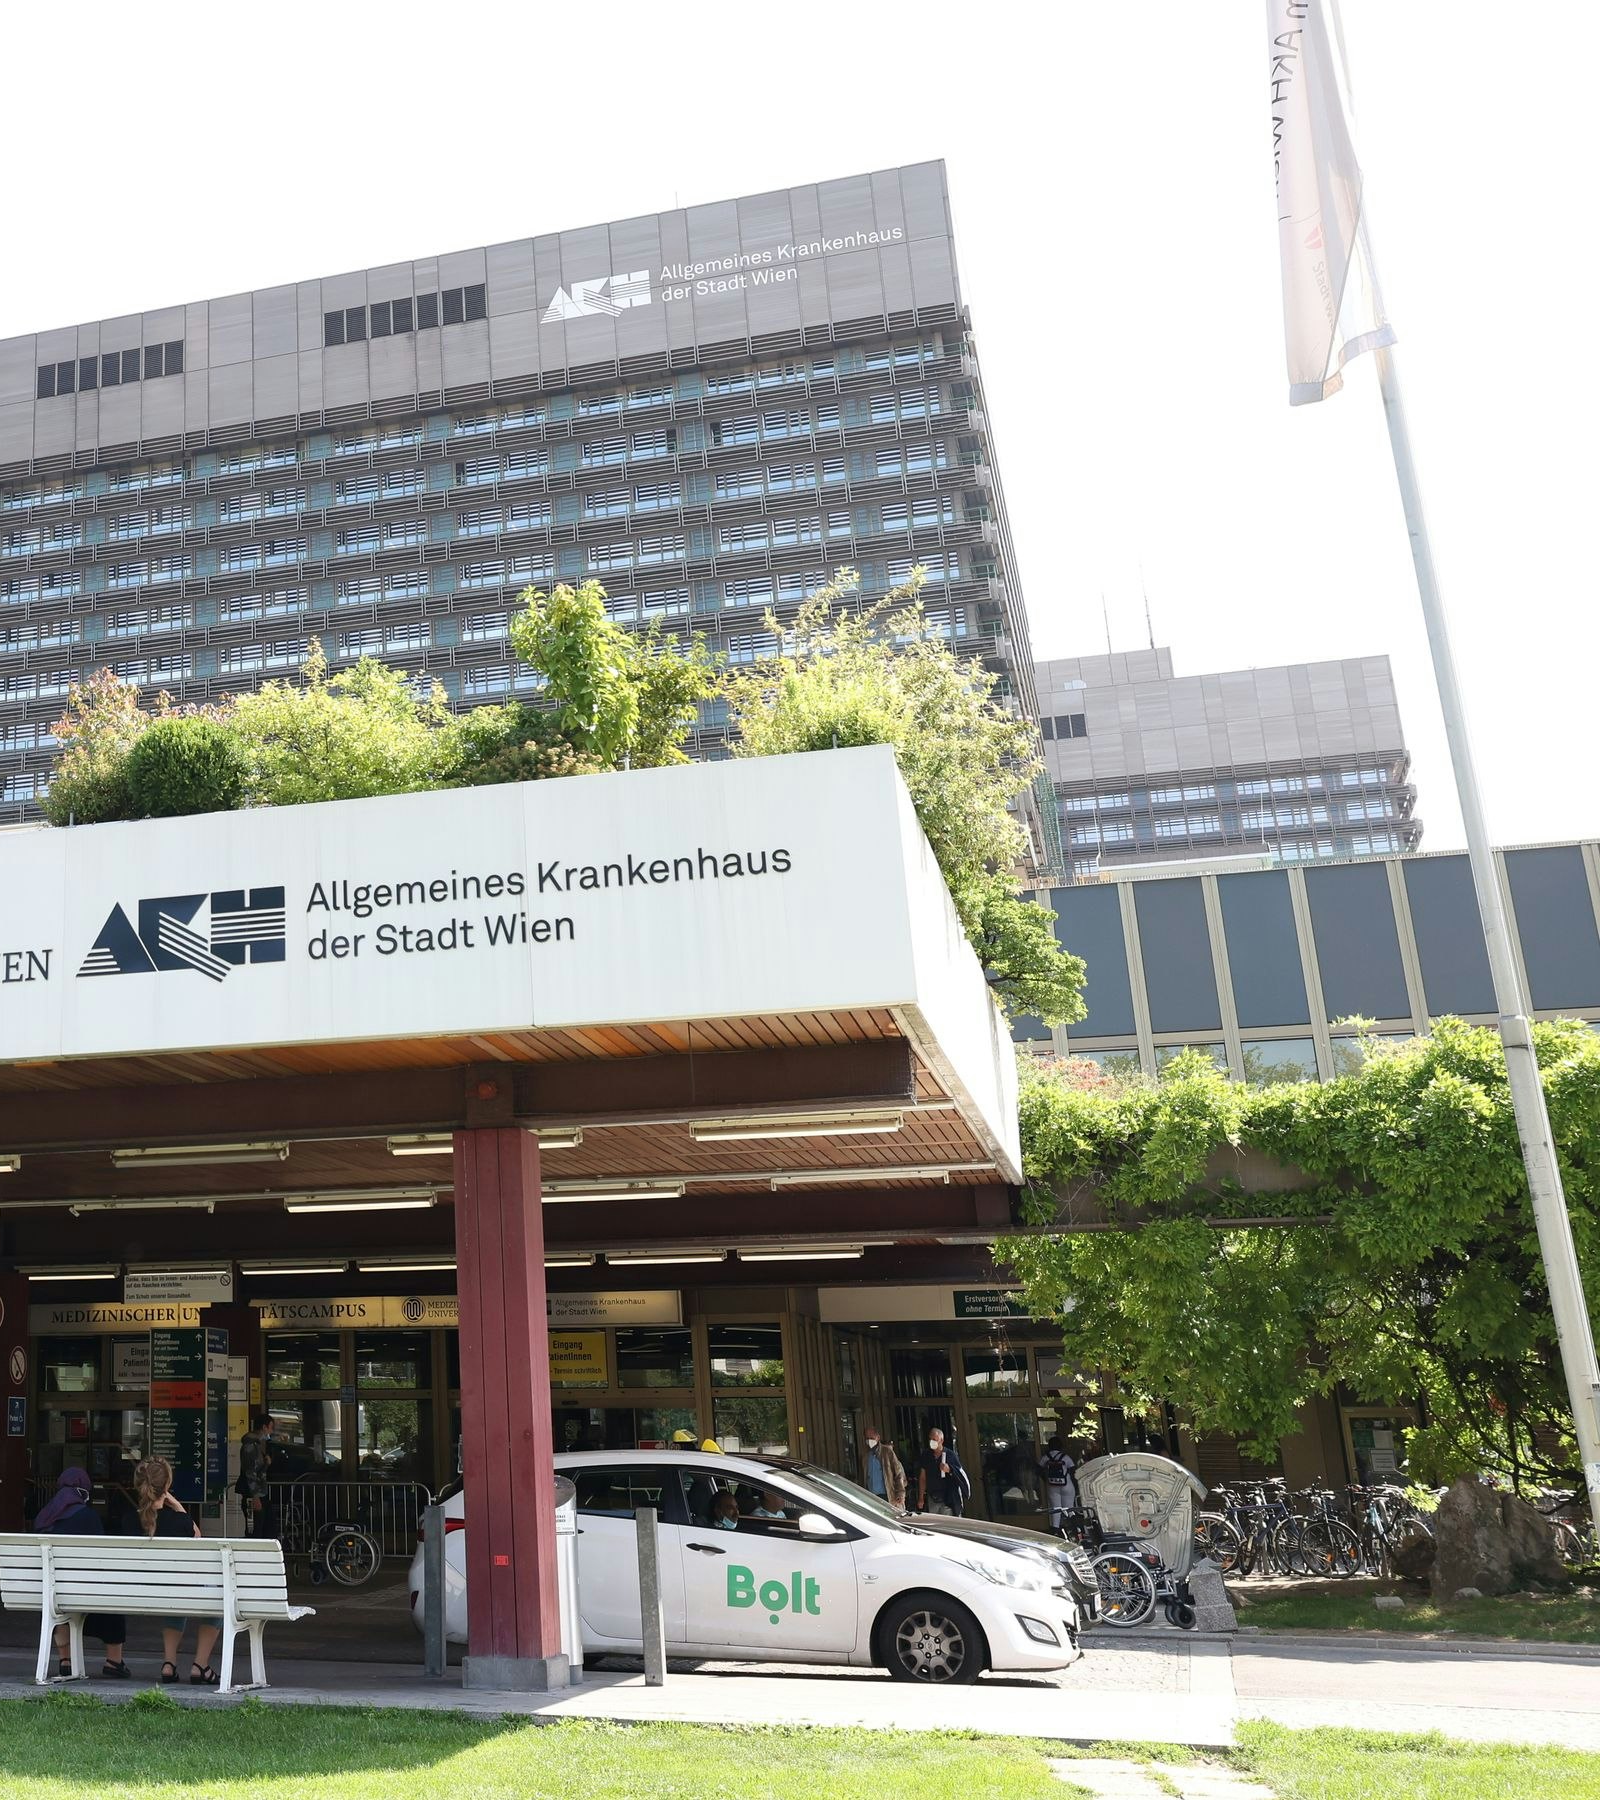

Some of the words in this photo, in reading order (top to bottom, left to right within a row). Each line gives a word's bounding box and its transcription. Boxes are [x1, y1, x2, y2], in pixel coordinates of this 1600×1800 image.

[660, 250, 772, 282] Allgemeines
[777, 226, 904, 262] Krankenhaus
[661, 283, 692, 302] der
[696, 273, 747, 298] Stadt
[751, 266, 798, 288] Wien
[305, 867, 526, 918] Allgemeines
[536, 845, 793, 895] Krankenhaus
[307, 927, 366, 960] der
[374, 917, 475, 955] Stadt
[483, 911, 575, 949] Wien
[555, 1299, 598, 1307] Allgemeines
[599, 1297, 646, 1305] Krankenhaus
[569, 1308, 588, 1316] Stadt
[52, 1308, 176, 1323] MEDIZINISCHER
[549, 1352, 592, 1360] atientInnen
[553, 1341, 583, 1350] Eingang
[727, 1564, 821, 1624] Bolt
